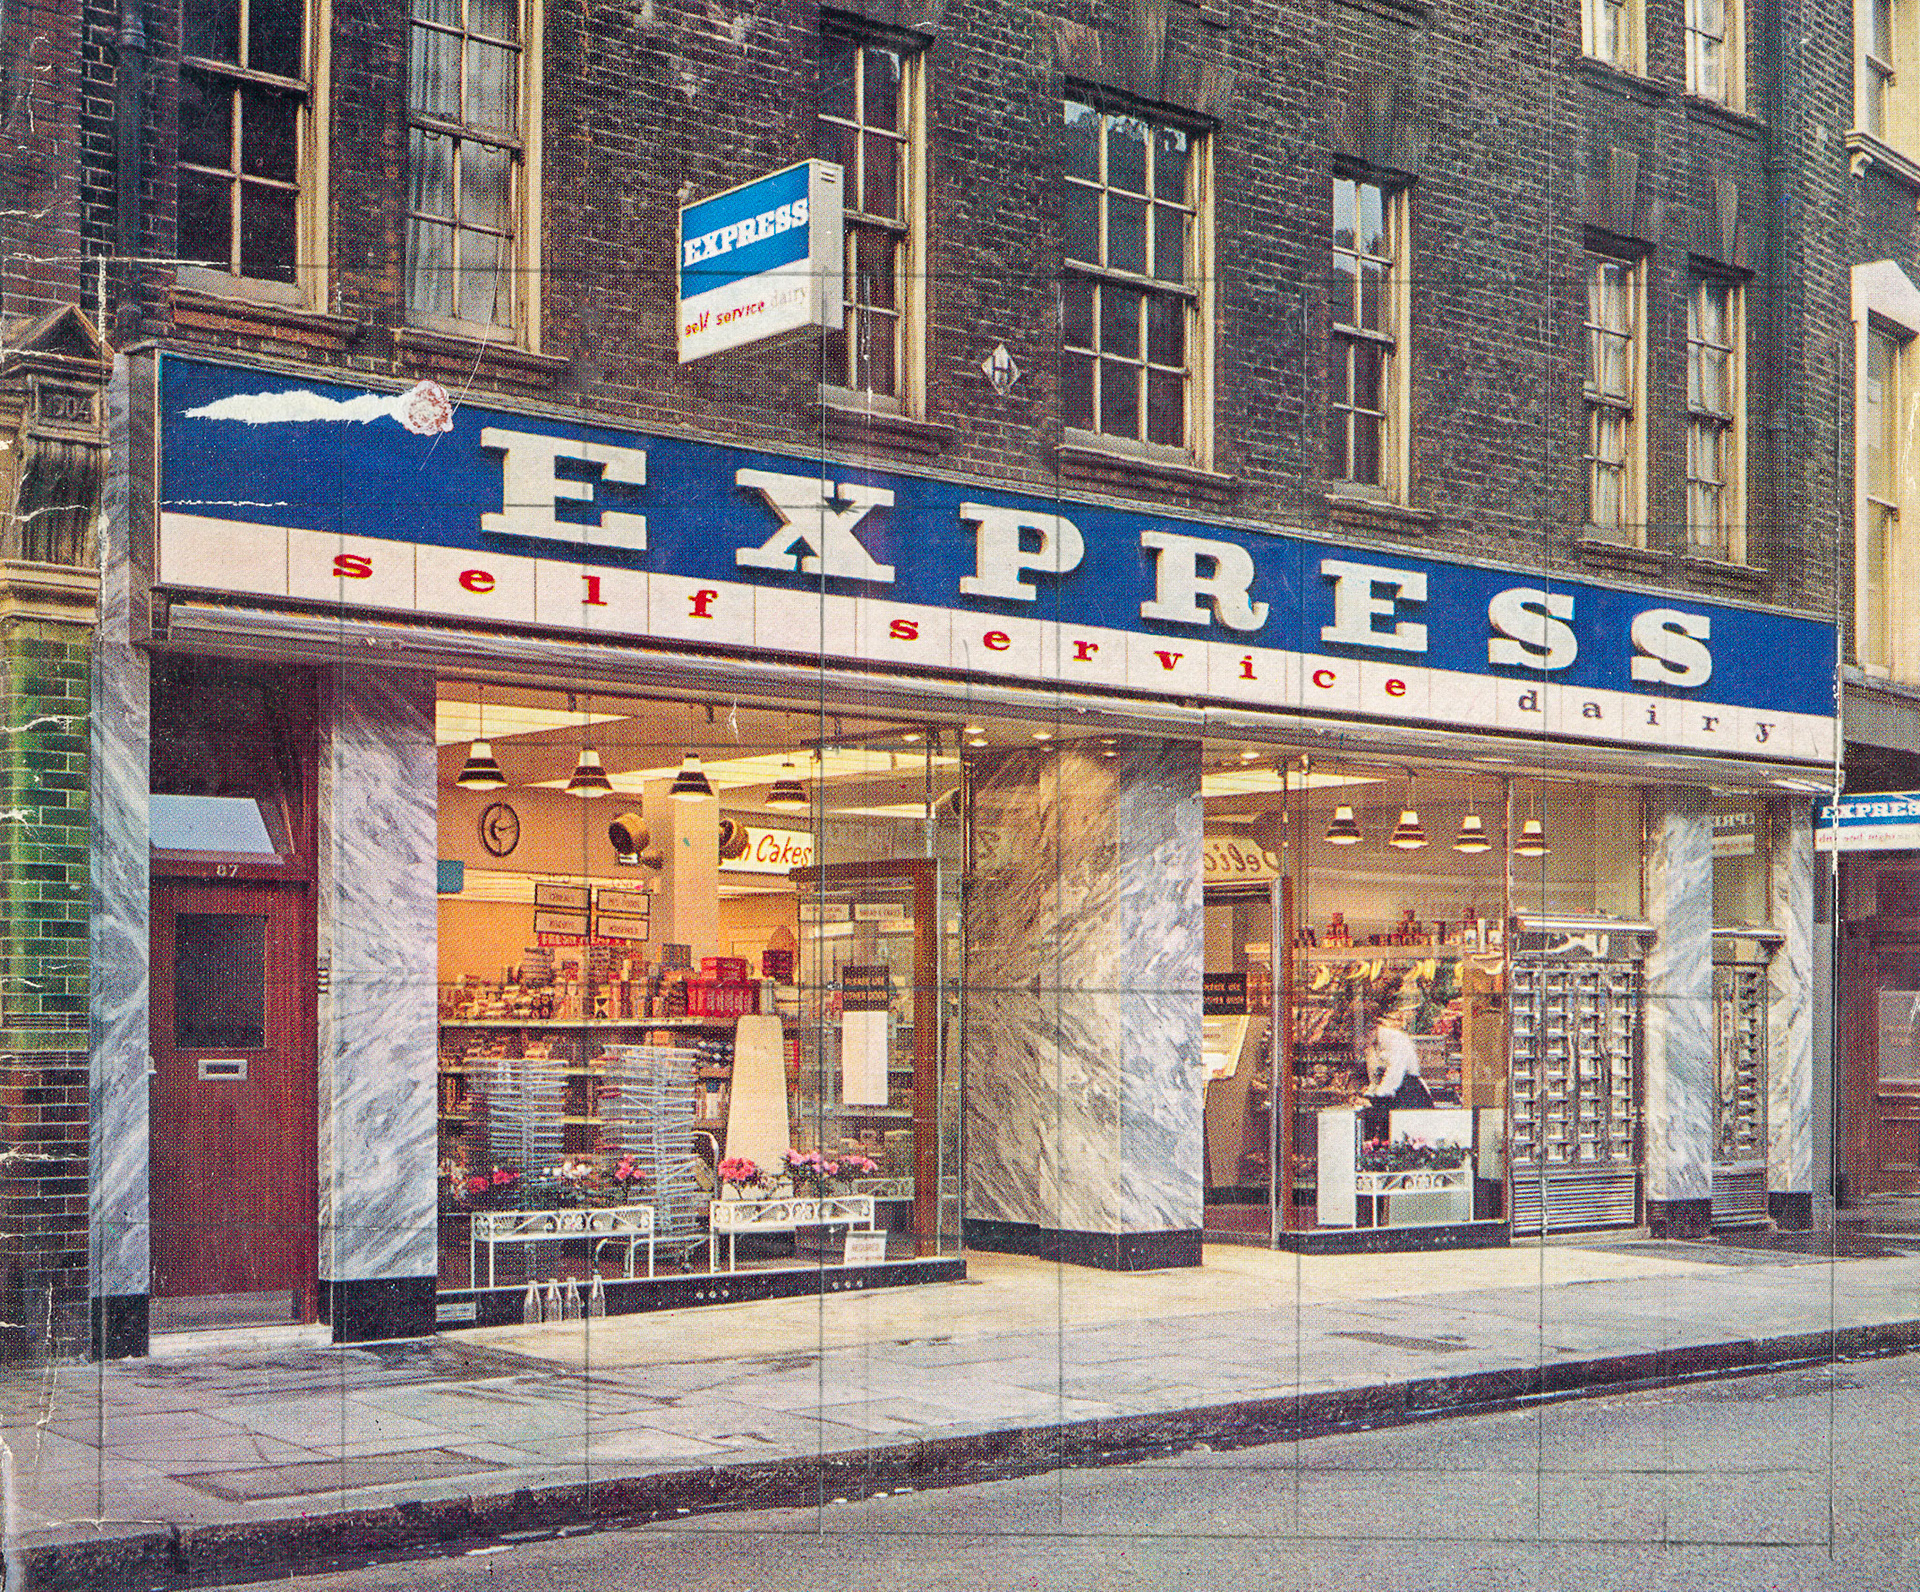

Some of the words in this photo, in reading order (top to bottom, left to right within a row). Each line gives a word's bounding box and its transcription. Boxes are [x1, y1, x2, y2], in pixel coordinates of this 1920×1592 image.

[683, 197, 810, 267] EXPRESS
[684, 309, 711, 338] self
[716, 300, 765, 326] service
[480, 426, 1712, 688] EXPRESS
[333, 552, 718, 618] self
[889, 617, 1407, 697] service
[1519, 690, 1777, 743] dairy
[757, 834, 812, 867] Cakes
